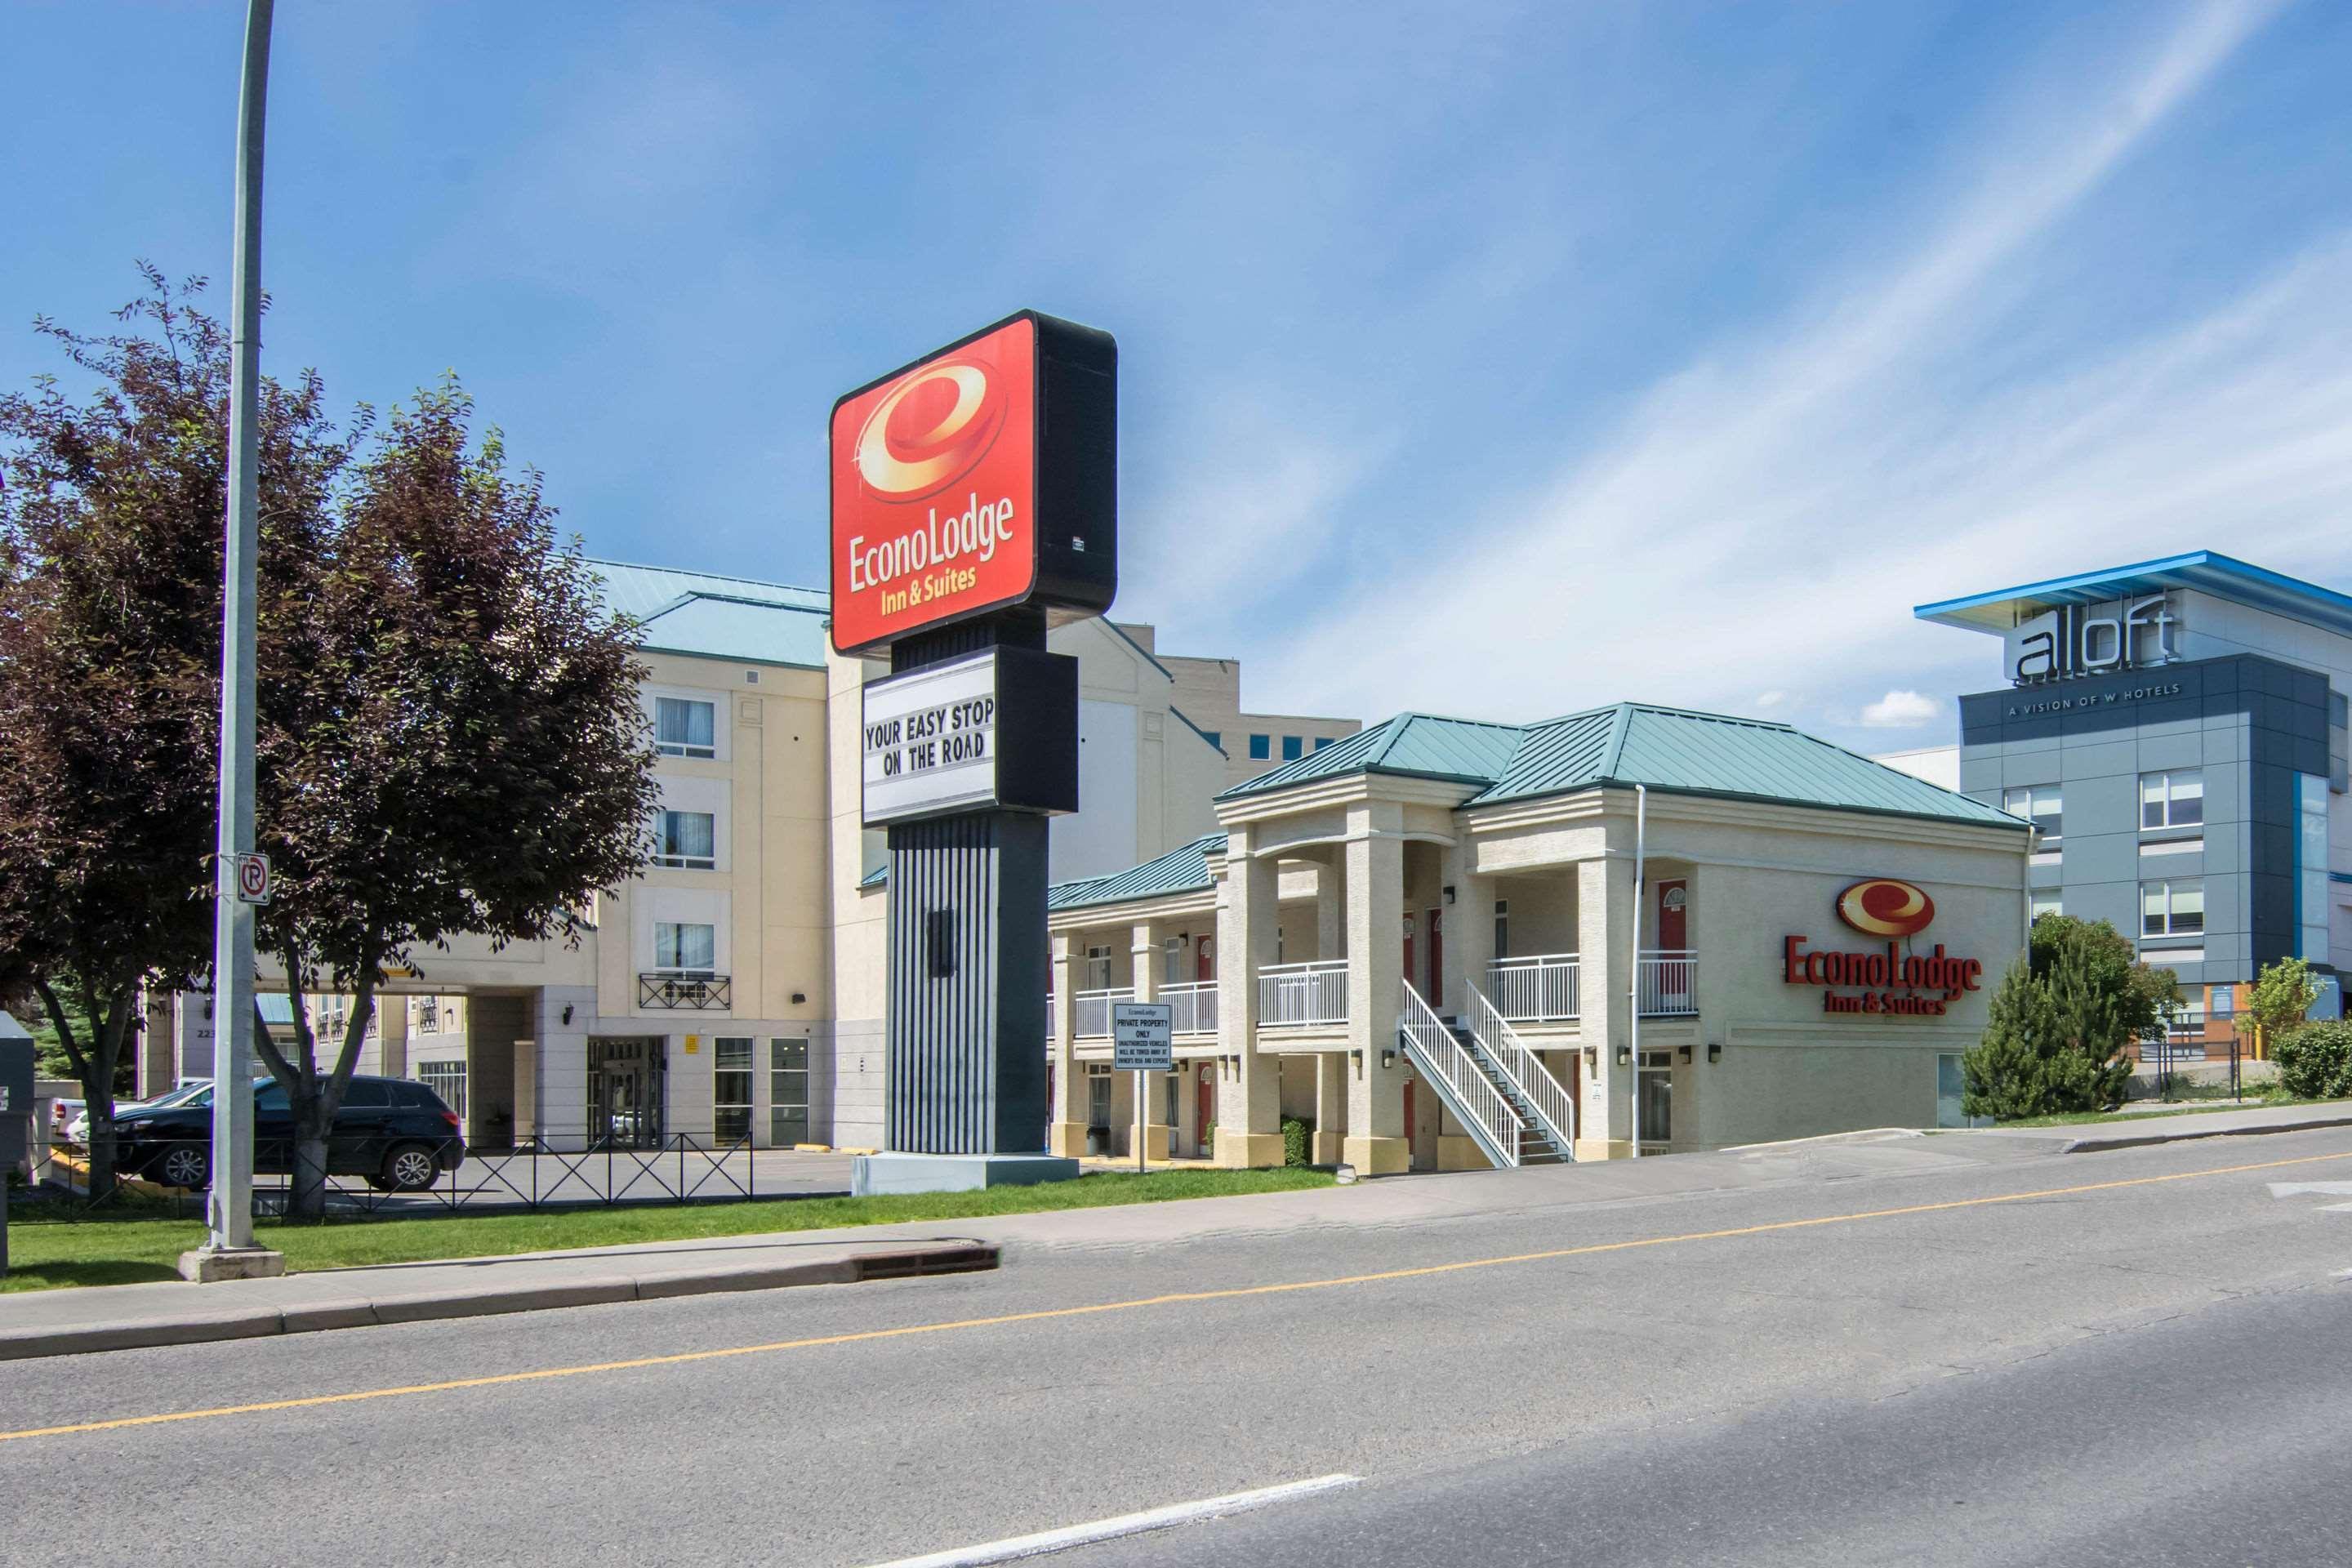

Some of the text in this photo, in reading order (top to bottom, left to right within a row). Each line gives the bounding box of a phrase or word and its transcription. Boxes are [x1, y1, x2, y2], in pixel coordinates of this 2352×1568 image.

[849, 492, 1014, 593] EconoLodge
[881, 566, 977, 616] Inn & Suites
[2017, 595, 2175, 679] aloft
[2009, 684, 2180, 716] A VISION OF W HOTELS
[866, 698, 994, 751] YOUR EASY STOP
[884, 733, 984, 776] ON THE ROAD
[1785, 935, 1982, 1000] EconoLodge
[1140, 1019, 1168, 1027] PROPERTY
[1824, 991, 1946, 1015] Inn & Suites
[1136, 1030, 1150, 1038] ONLY
